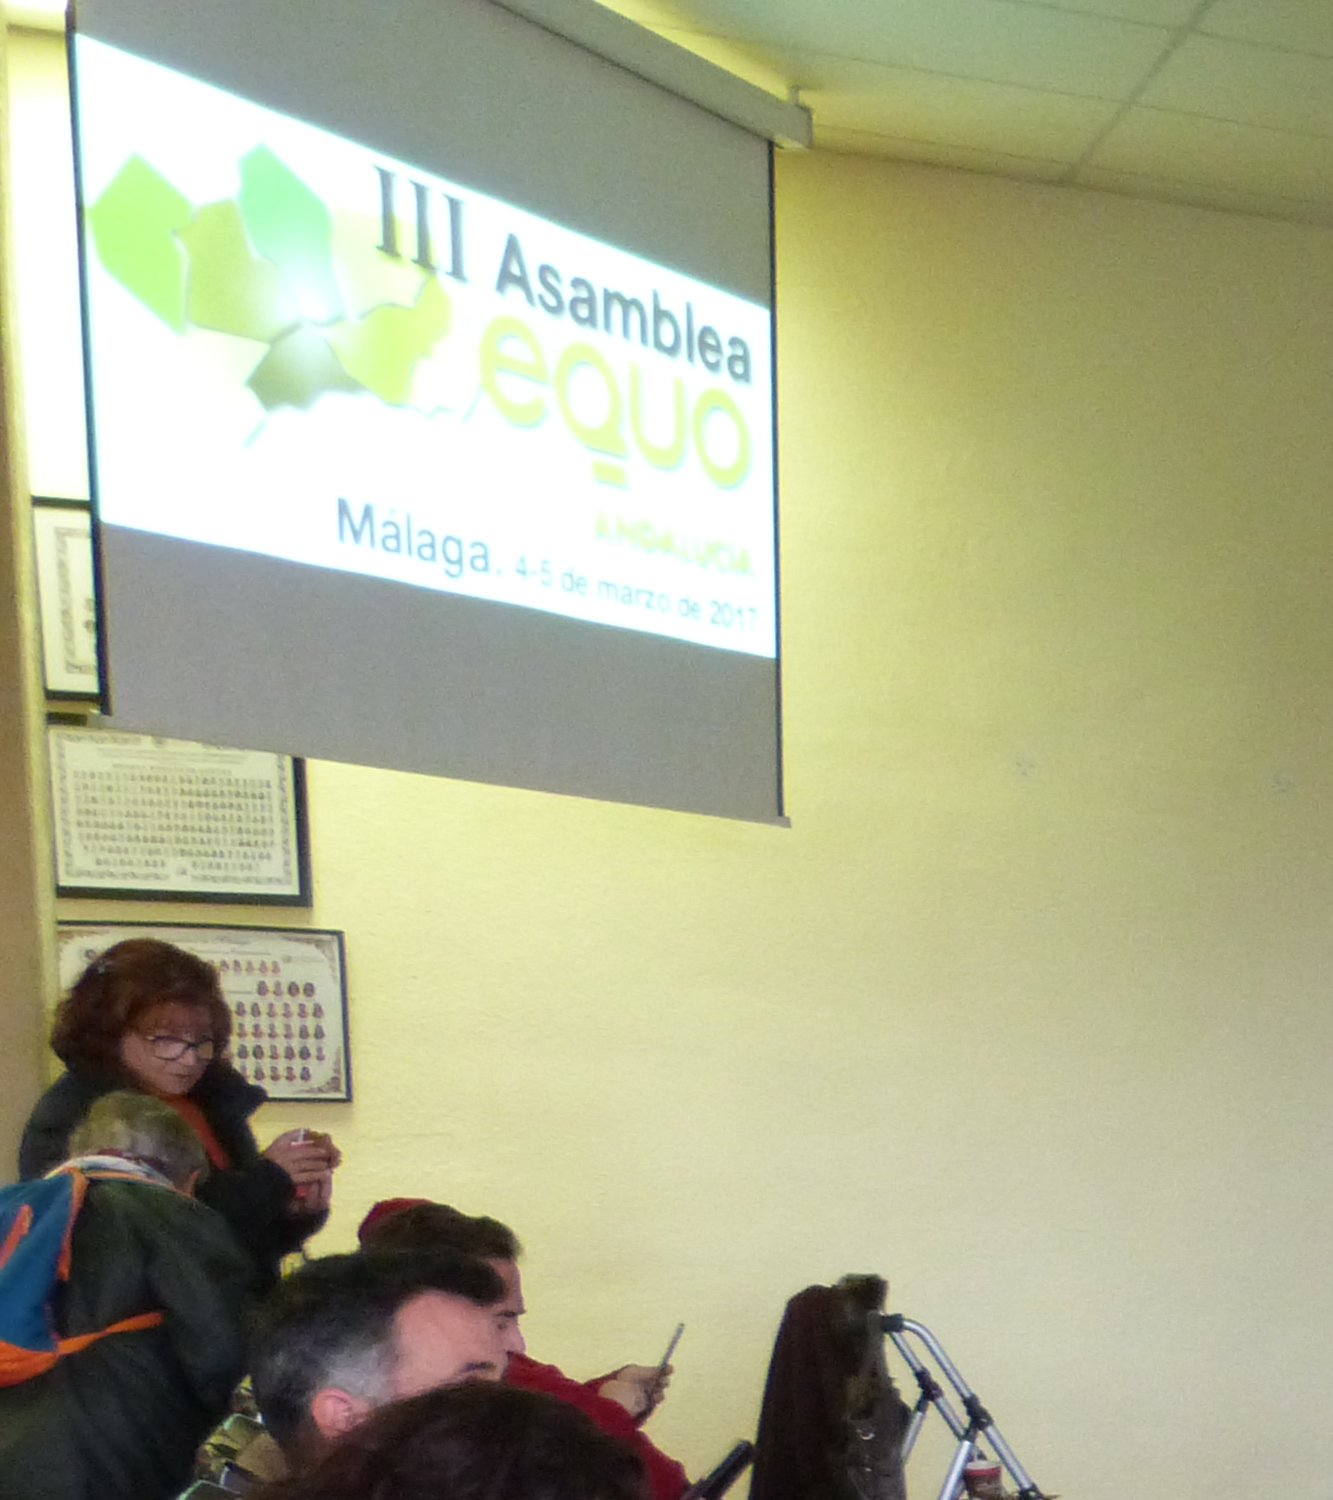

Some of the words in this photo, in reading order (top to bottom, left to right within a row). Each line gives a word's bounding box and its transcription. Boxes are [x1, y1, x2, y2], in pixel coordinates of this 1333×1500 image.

[374, 165, 468, 282] III
[495, 233, 752, 384] Asamblea
[562, 570, 588, 596] de
[598, 577, 672, 614] marzo
[678, 594, 702, 621] de
[710, 600, 759, 633] 2017
